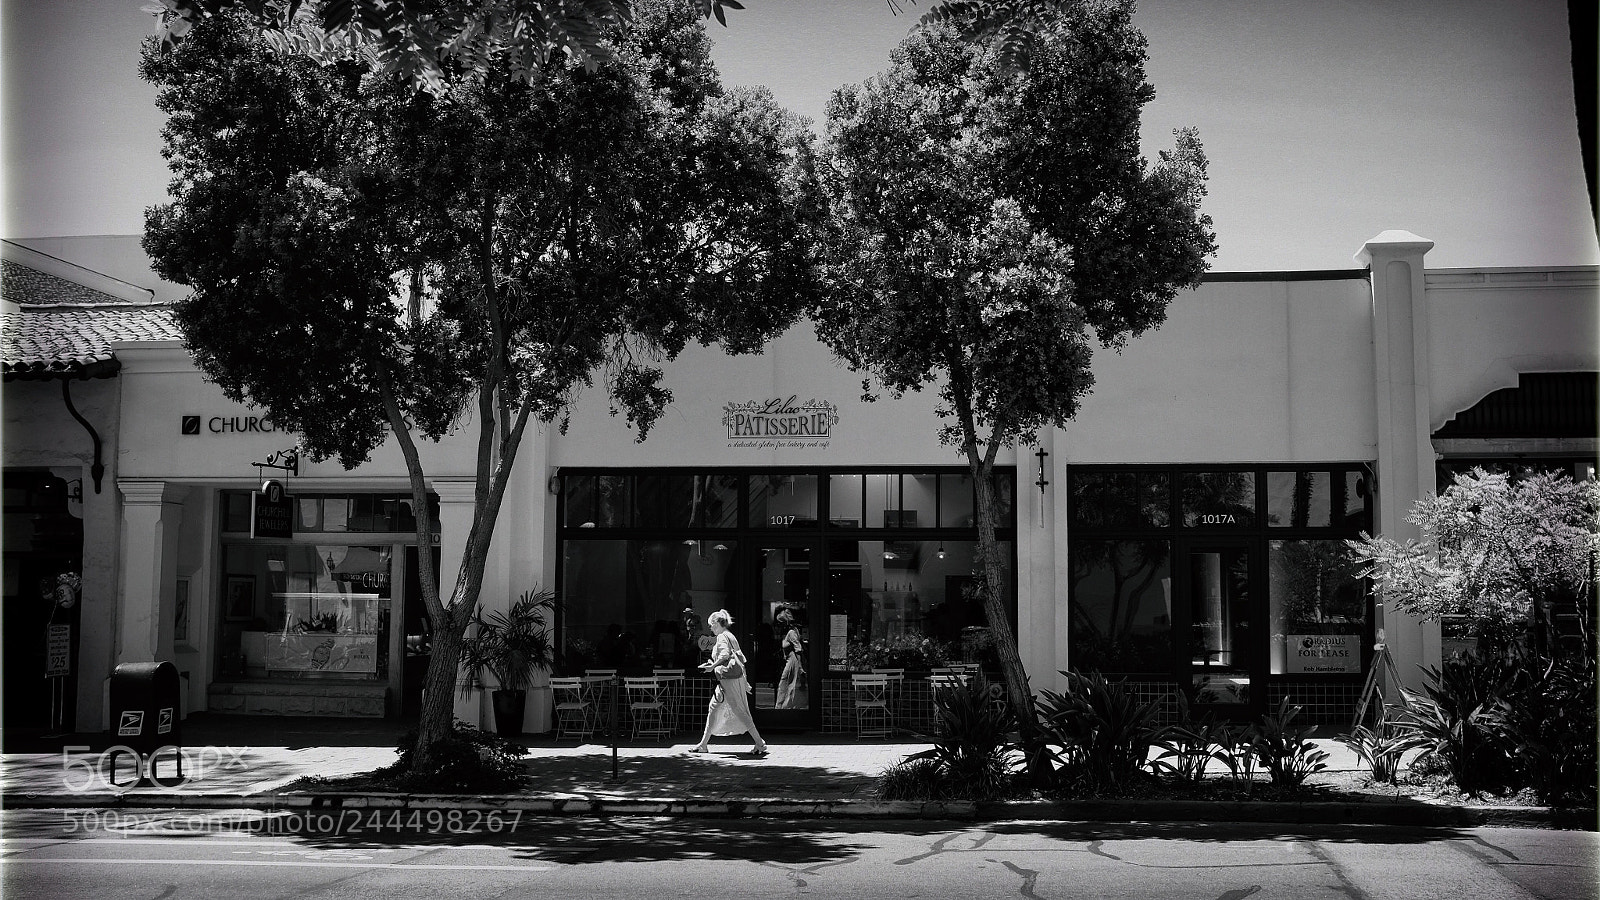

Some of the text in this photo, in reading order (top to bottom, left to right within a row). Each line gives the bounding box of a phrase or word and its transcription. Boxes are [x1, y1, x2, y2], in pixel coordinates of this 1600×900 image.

[757, 394, 800, 415] Lilac
[770, 515, 795, 525] 1017
[1201, 514, 1236, 524] 1017A
[1314, 637, 1346, 646] RADIUS
[1298, 649, 1350, 658] FOR LEASE
